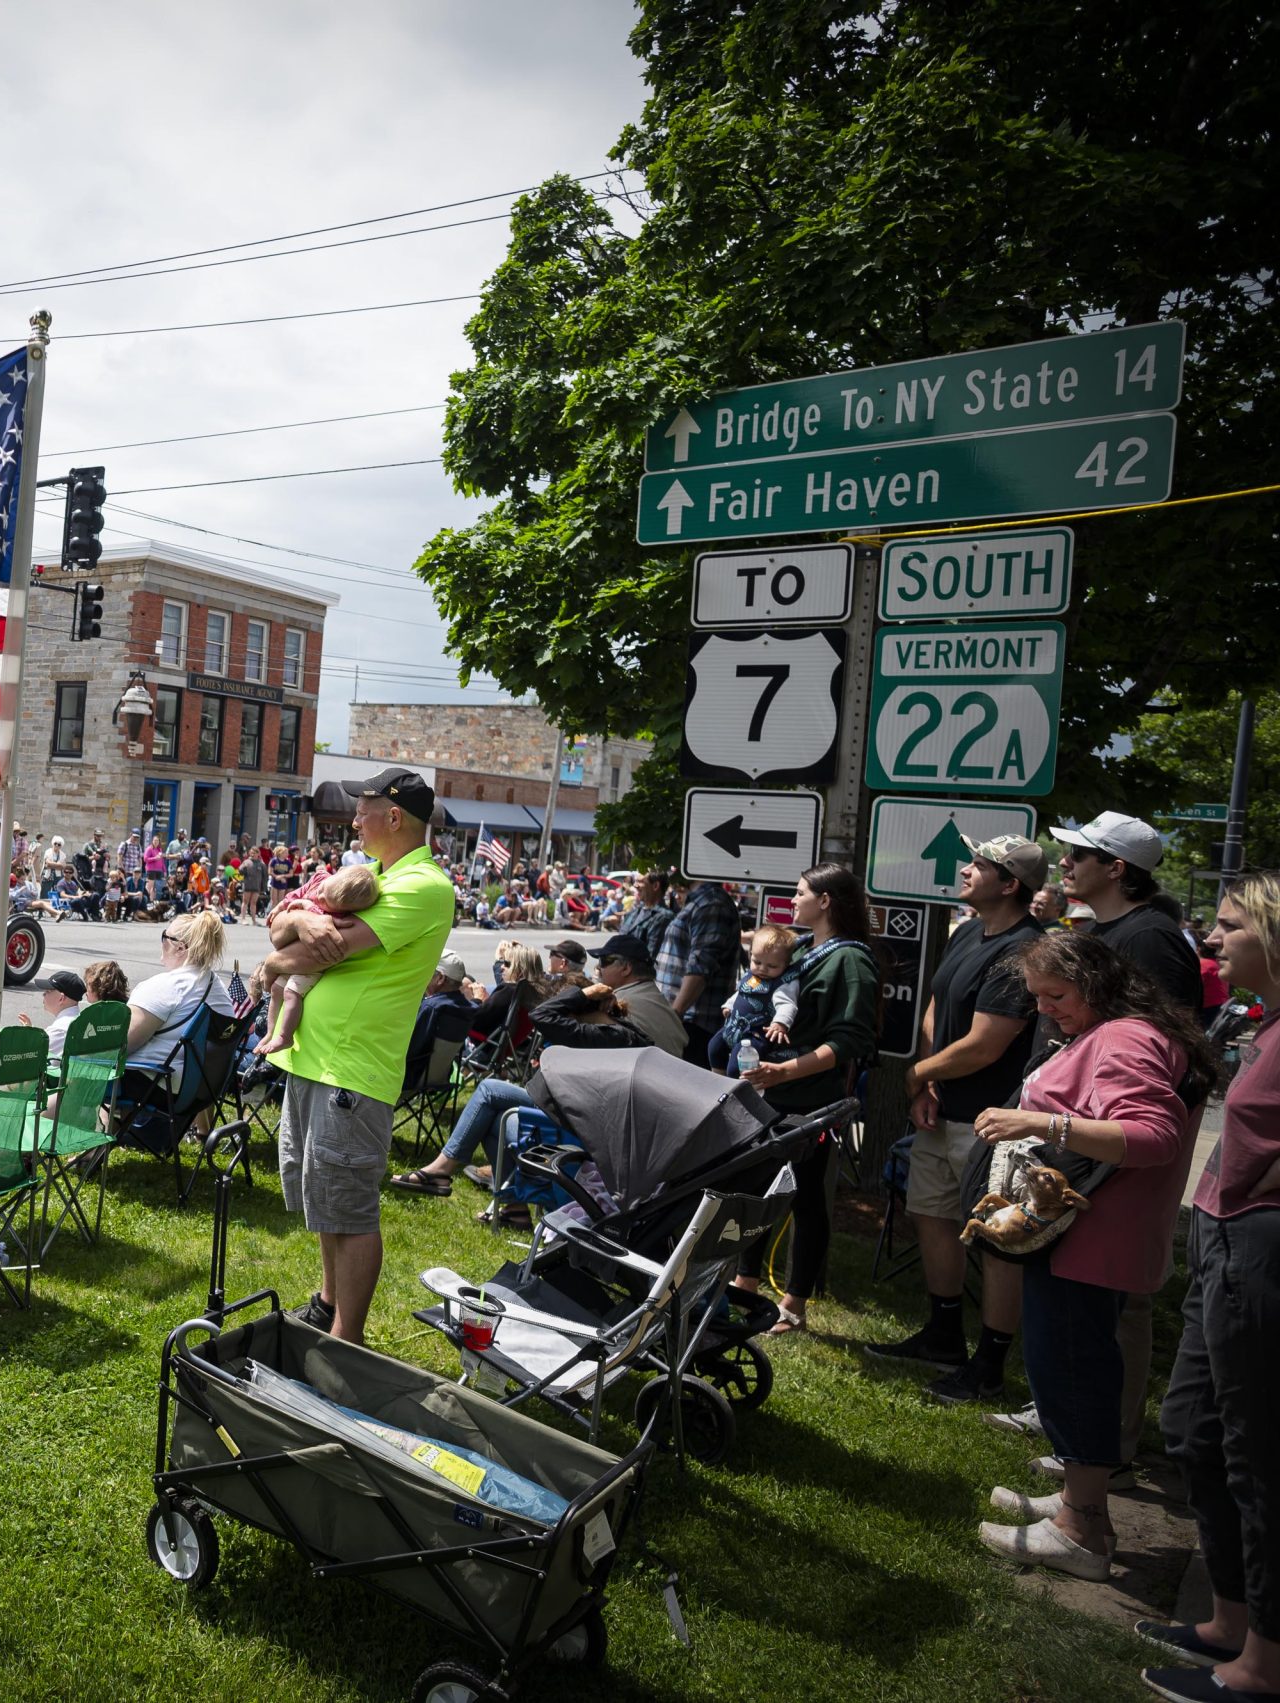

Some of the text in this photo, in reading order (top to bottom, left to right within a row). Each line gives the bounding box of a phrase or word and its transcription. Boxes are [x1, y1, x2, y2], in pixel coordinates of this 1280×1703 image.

[716, 344, 1157, 453] Bridge To NY State 14
[708, 436, 1149, 522] Fair Haven 42
[737, 565, 806, 608] TO
[897, 548, 1054, 603] SOUTH
[895, 637, 1043, 670] VERMONT
[223, 682, 254, 696] INSURANCE
[256, 688, 278, 700] AGENCY
[735, 664, 791, 743] 7
[892, 691, 1026, 781] 22A
